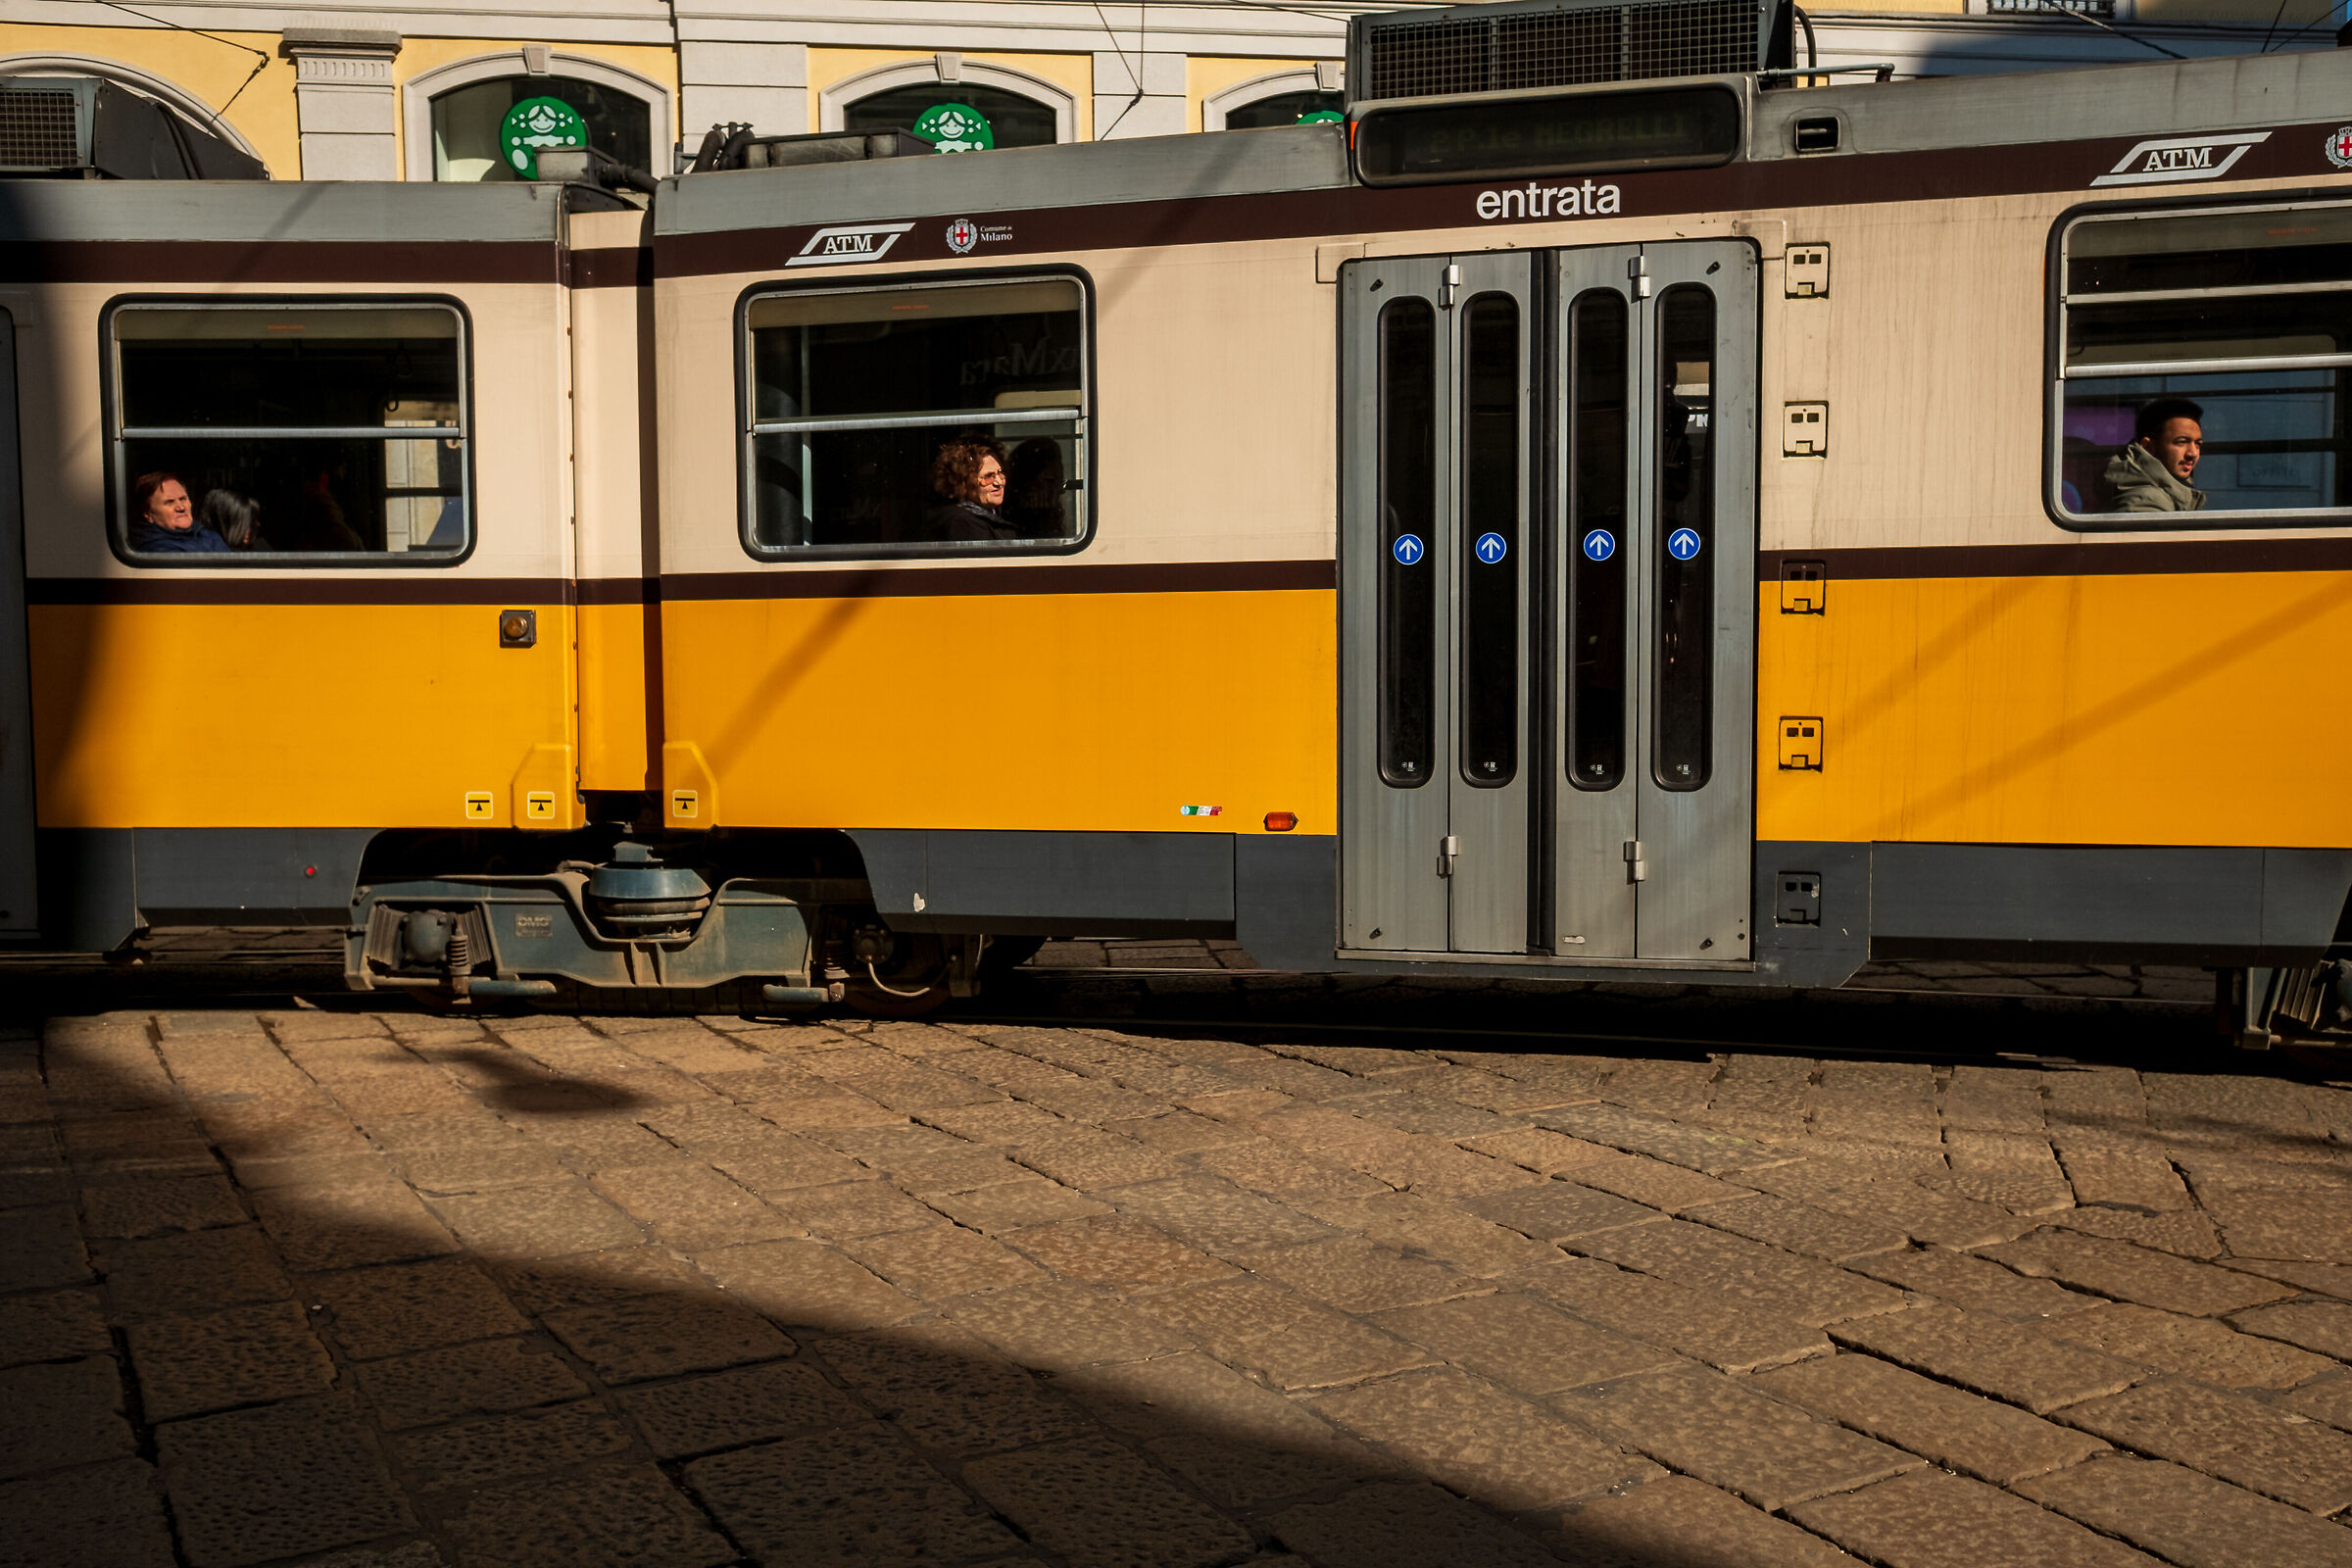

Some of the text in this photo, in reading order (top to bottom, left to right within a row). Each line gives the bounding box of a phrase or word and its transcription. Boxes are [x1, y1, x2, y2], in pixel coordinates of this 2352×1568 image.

[2142, 146, 2213, 172] ATM
[1476, 178, 1621, 220] entrata
[822, 234, 873, 255] ATM
[980, 232, 1013, 242] Milano
